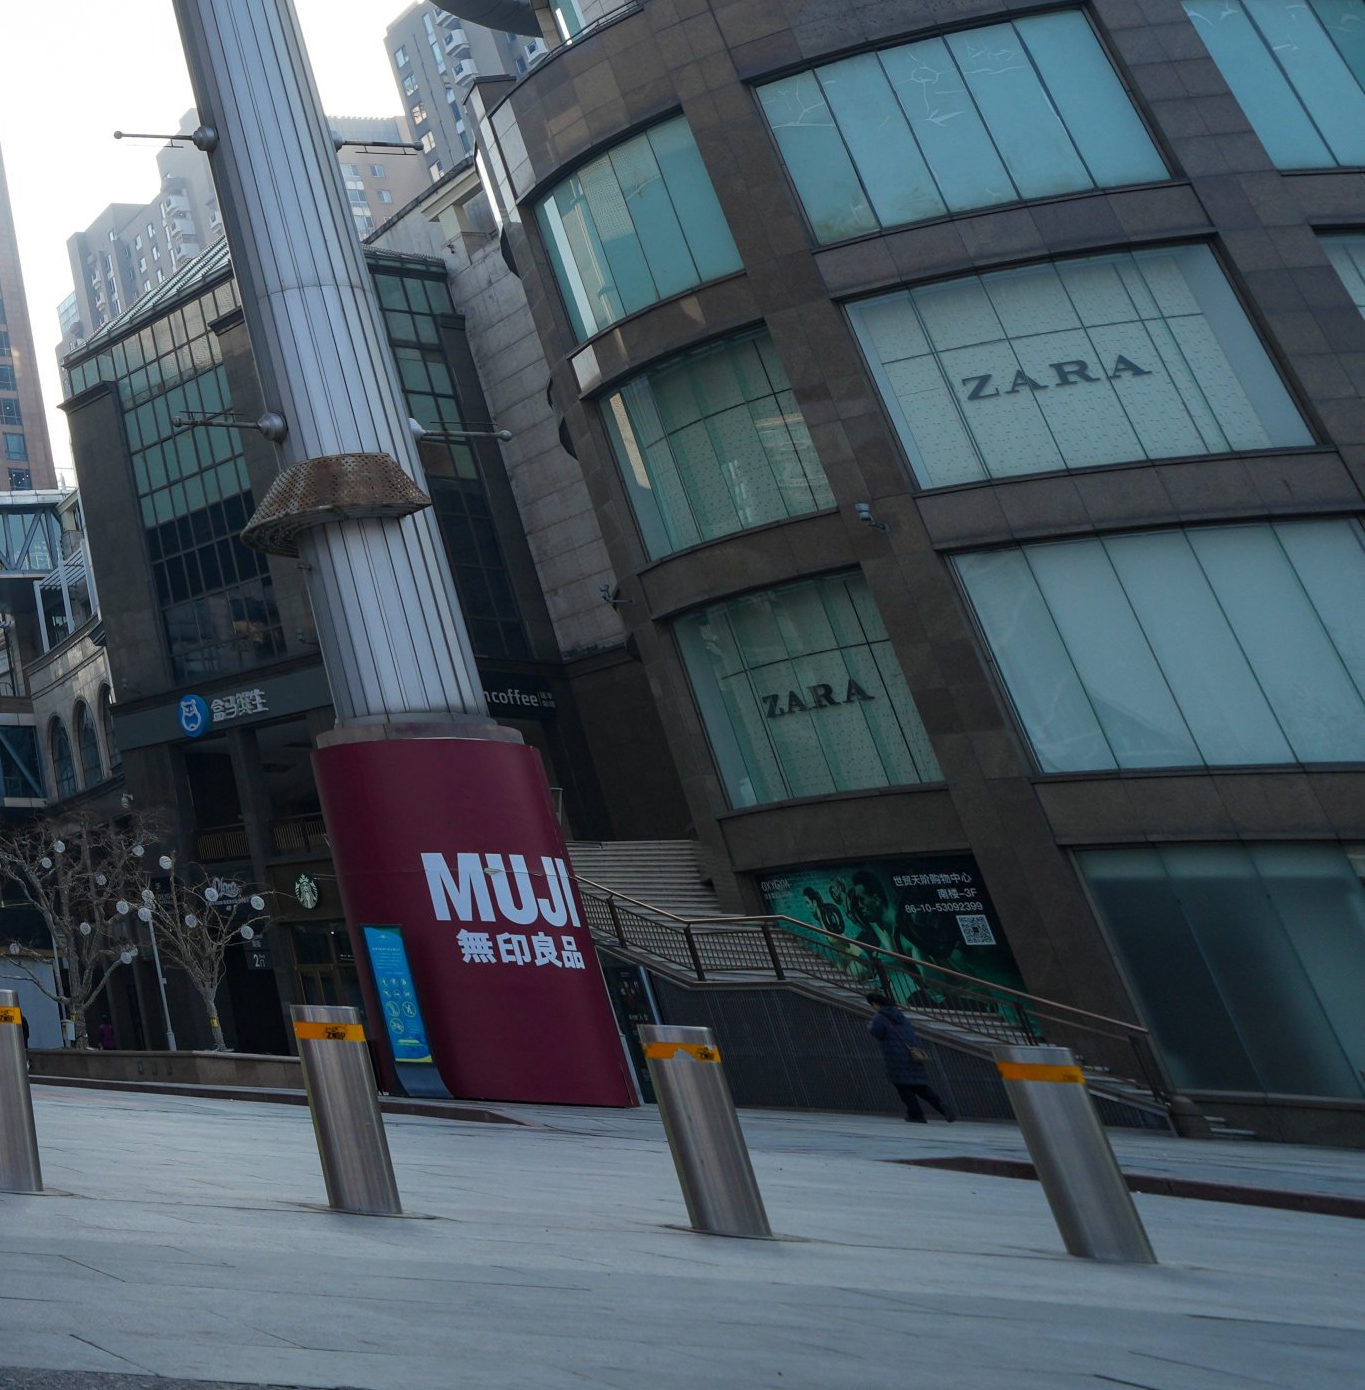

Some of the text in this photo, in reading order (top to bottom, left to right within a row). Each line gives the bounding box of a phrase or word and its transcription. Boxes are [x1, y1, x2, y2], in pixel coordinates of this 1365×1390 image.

[961, 354, 1153, 401] ZARA
[761, 678, 876, 719] ZARA
[421, 852, 581, 928] MUJI
[456, 928, 586, 970] 無印良品
